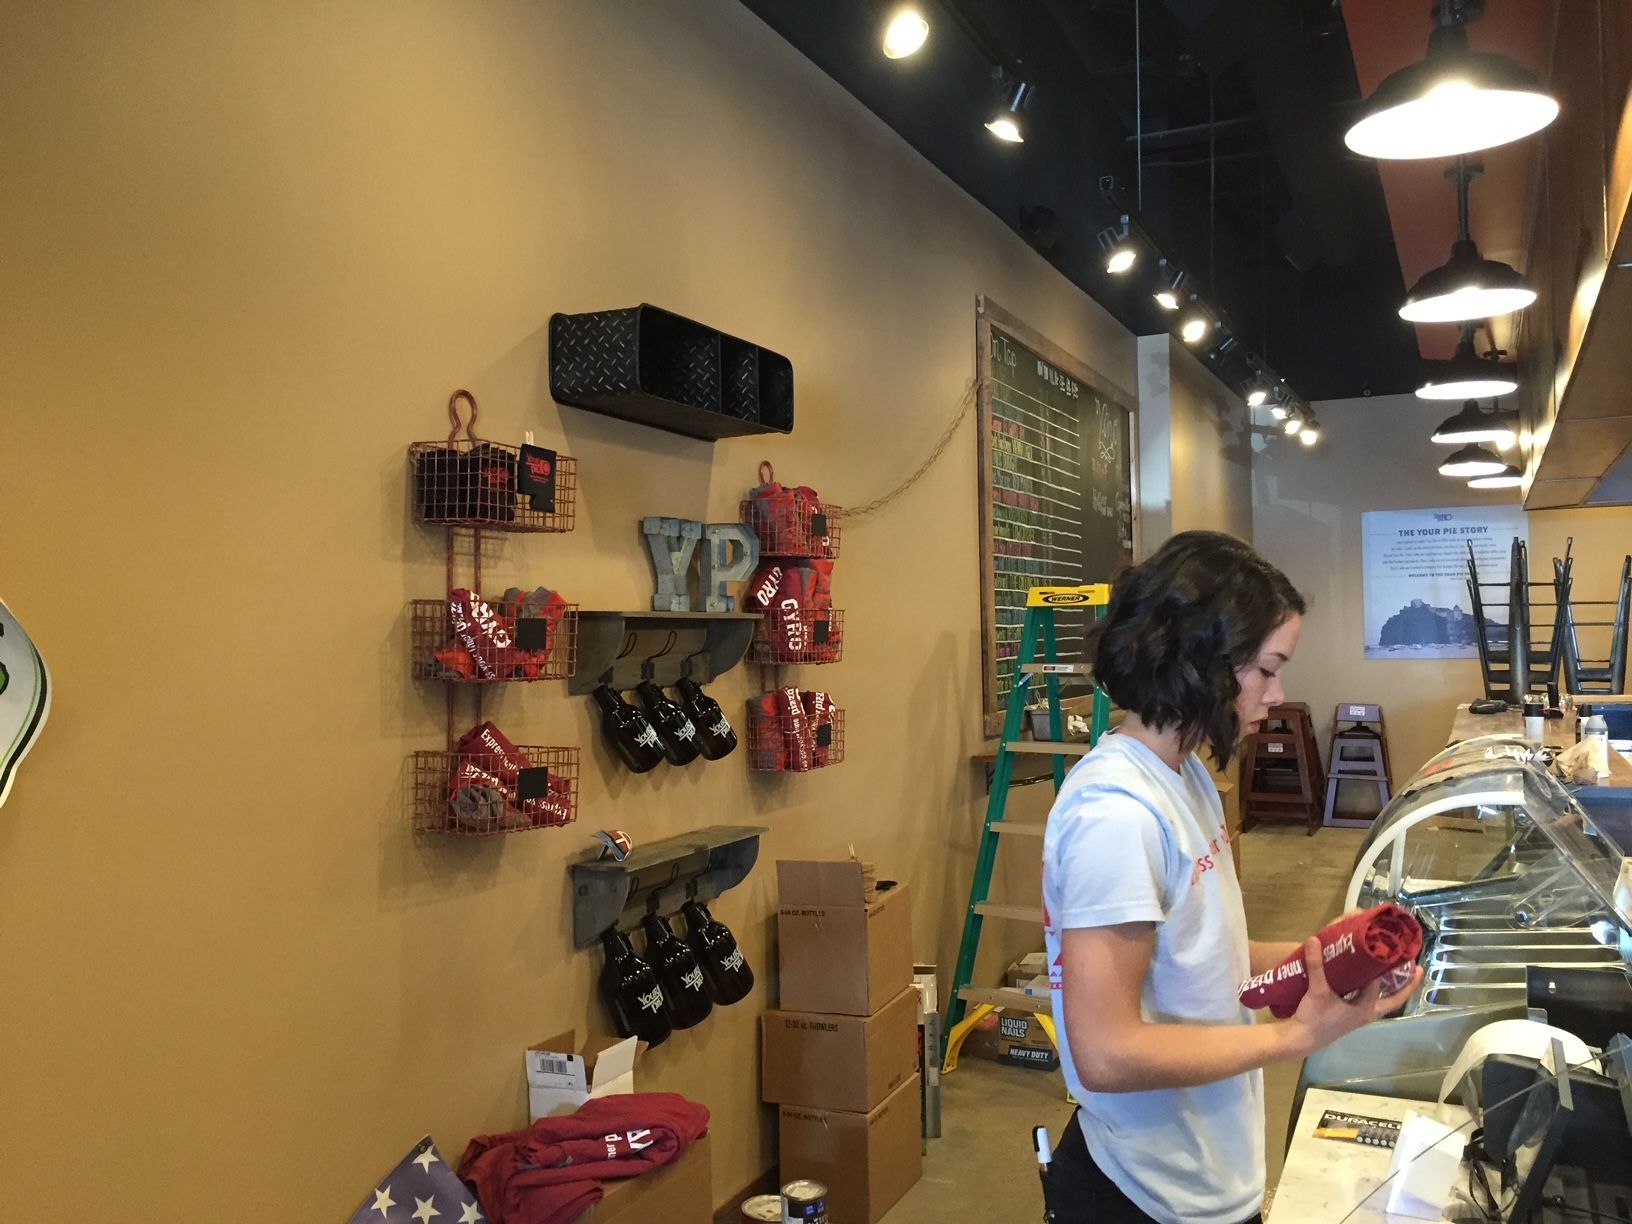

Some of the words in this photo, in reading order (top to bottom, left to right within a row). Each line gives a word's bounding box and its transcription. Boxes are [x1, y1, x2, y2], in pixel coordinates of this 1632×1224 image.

[1399, 529, 1415, 537] THE
[1416, 528, 1441, 536] YOUR
[1443, 527, 1457, 535] PIE
[1460, 526, 1488, 534] STORY
[756, 566, 783, 606] GYRO
[781, 598, 802, 651] GYRO
[786, 687, 801, 716] pizza
[1324, 933, 1356, 962] Express
[1001, 1018, 1027, 1029] LIQUID
[1001, 1027, 1025, 1037] NAILS
[1010, 1049, 1030, 1057] HEAVY
[1031, 1050, 1049, 1059] DUTY
